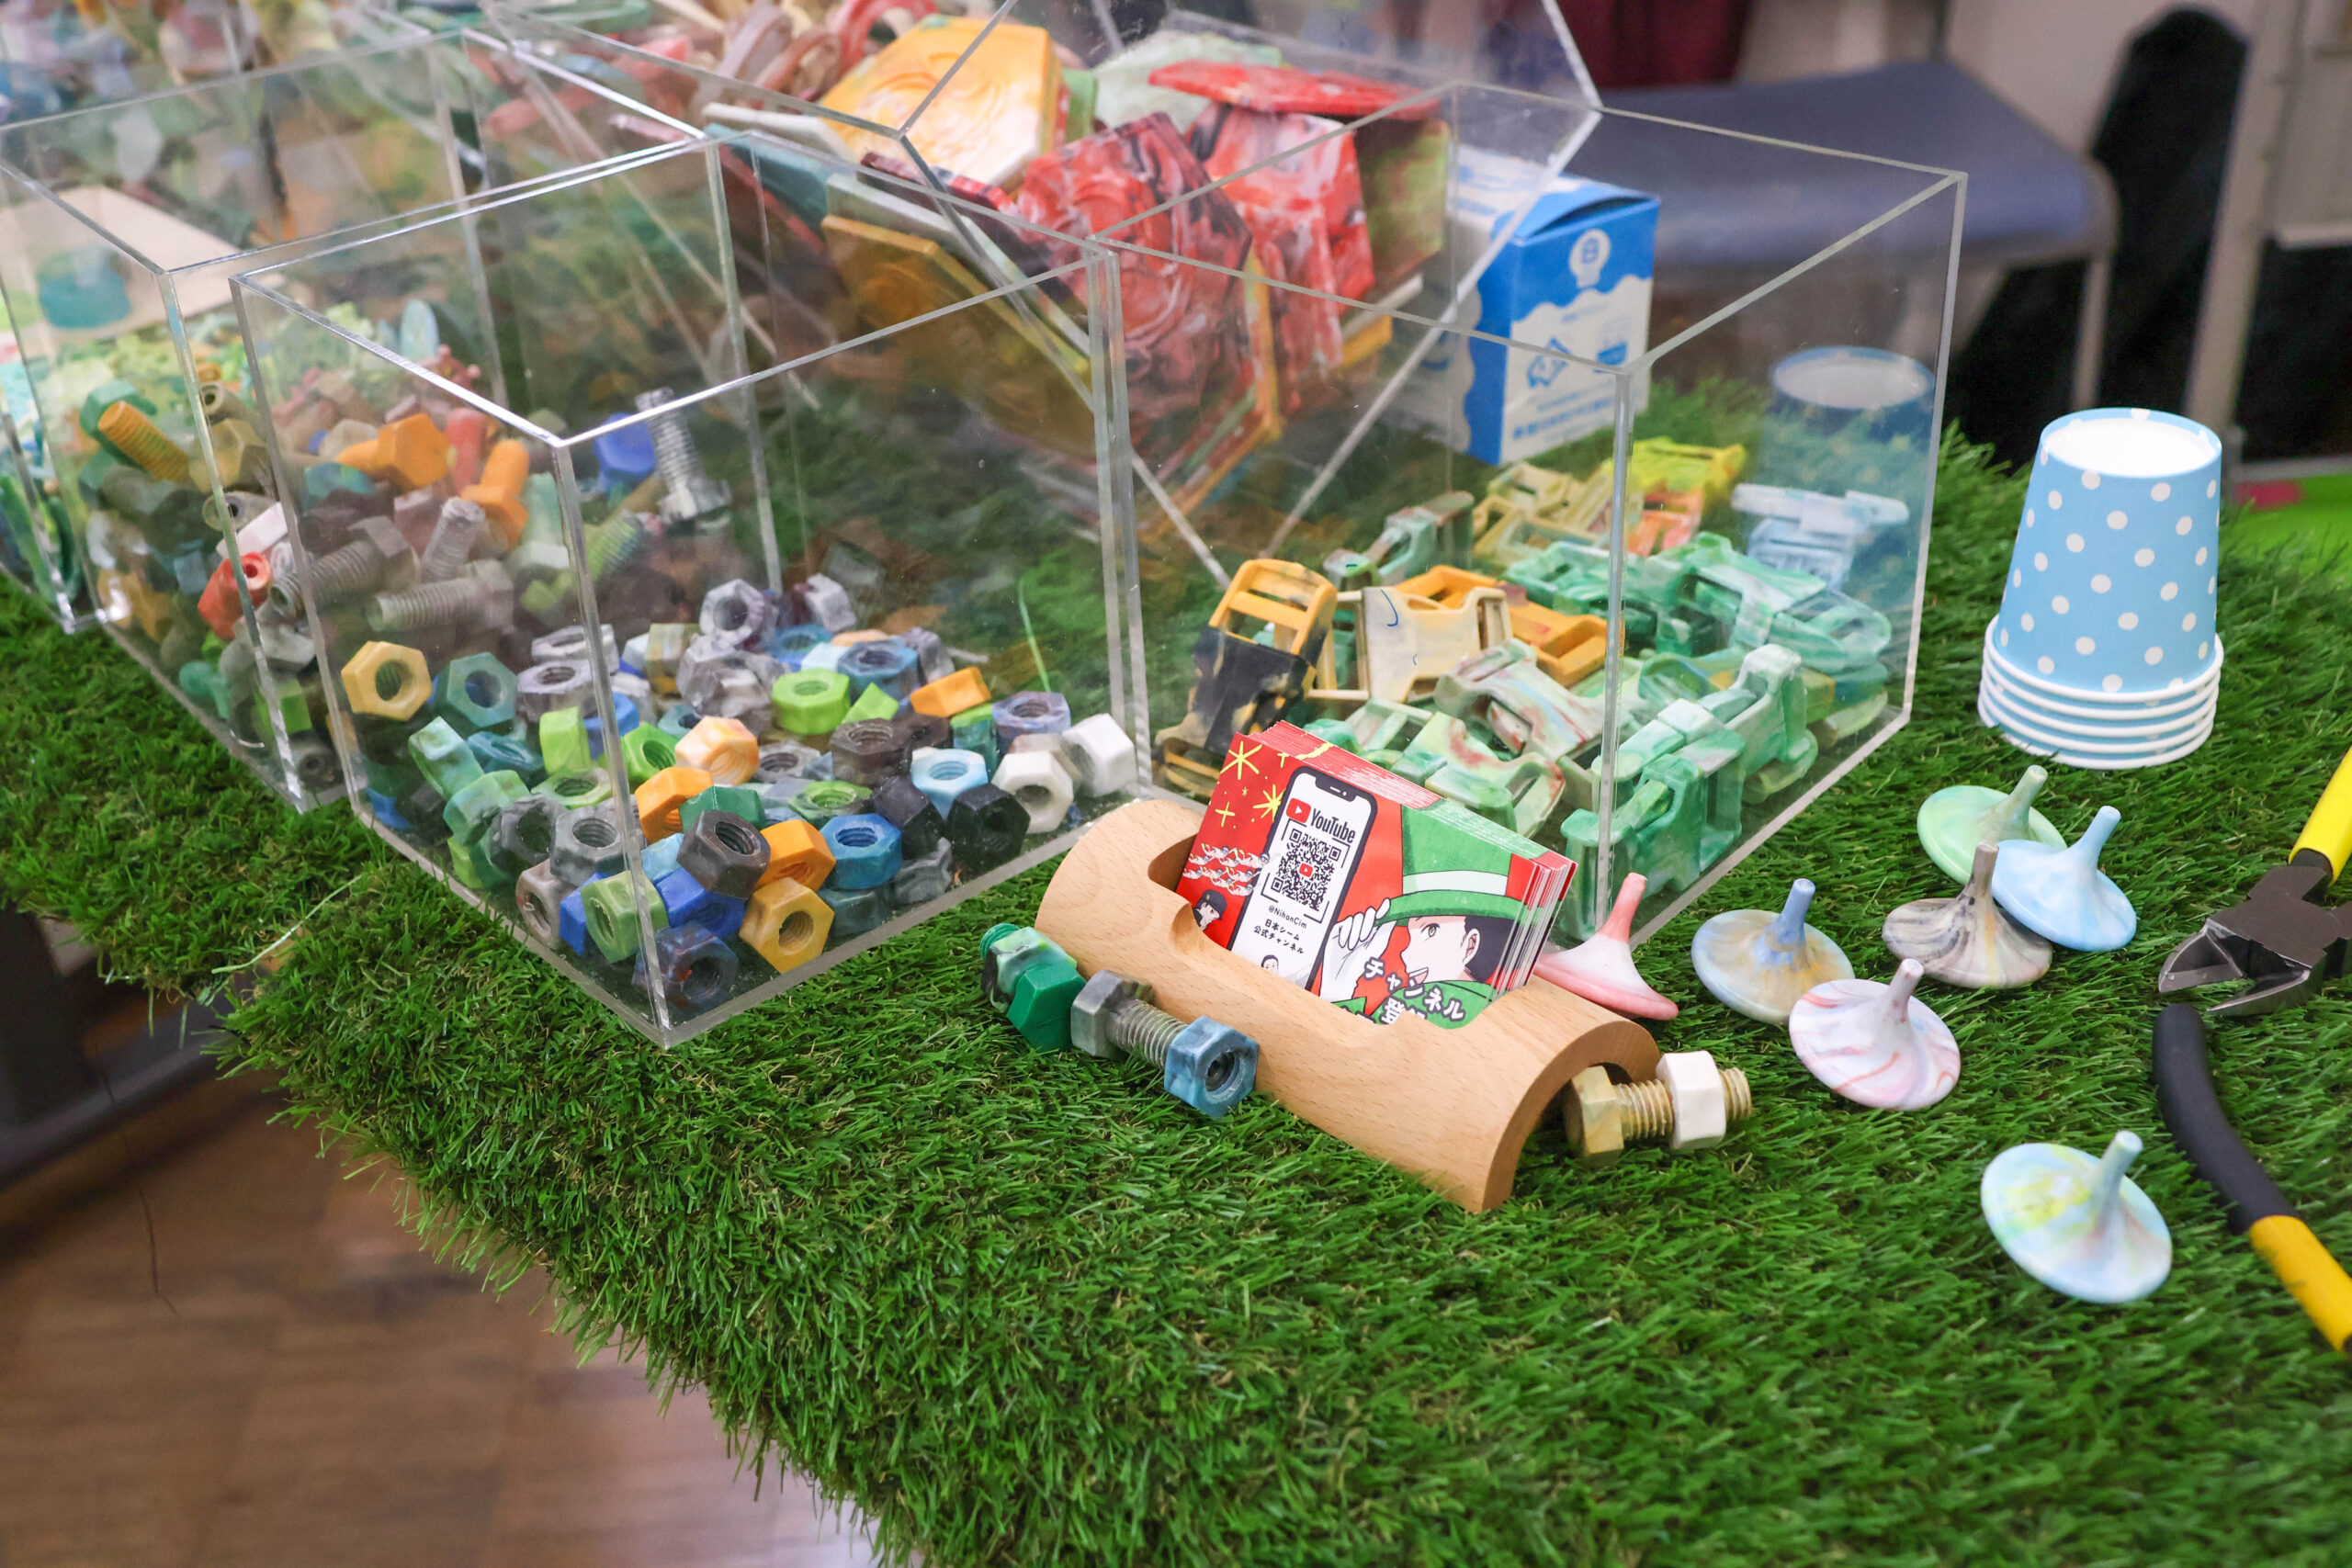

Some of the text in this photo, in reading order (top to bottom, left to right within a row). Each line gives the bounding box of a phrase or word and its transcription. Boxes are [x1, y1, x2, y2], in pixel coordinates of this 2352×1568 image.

[1311, 807, 1356, 844] YouTube
[1264, 919, 1301, 942] 日本シーム
[1268, 905, 1307, 930] @NihonCim
[1253, 925, 1305, 954] 公式チャンネル
[1364, 957, 1466, 1021] チャンネル
